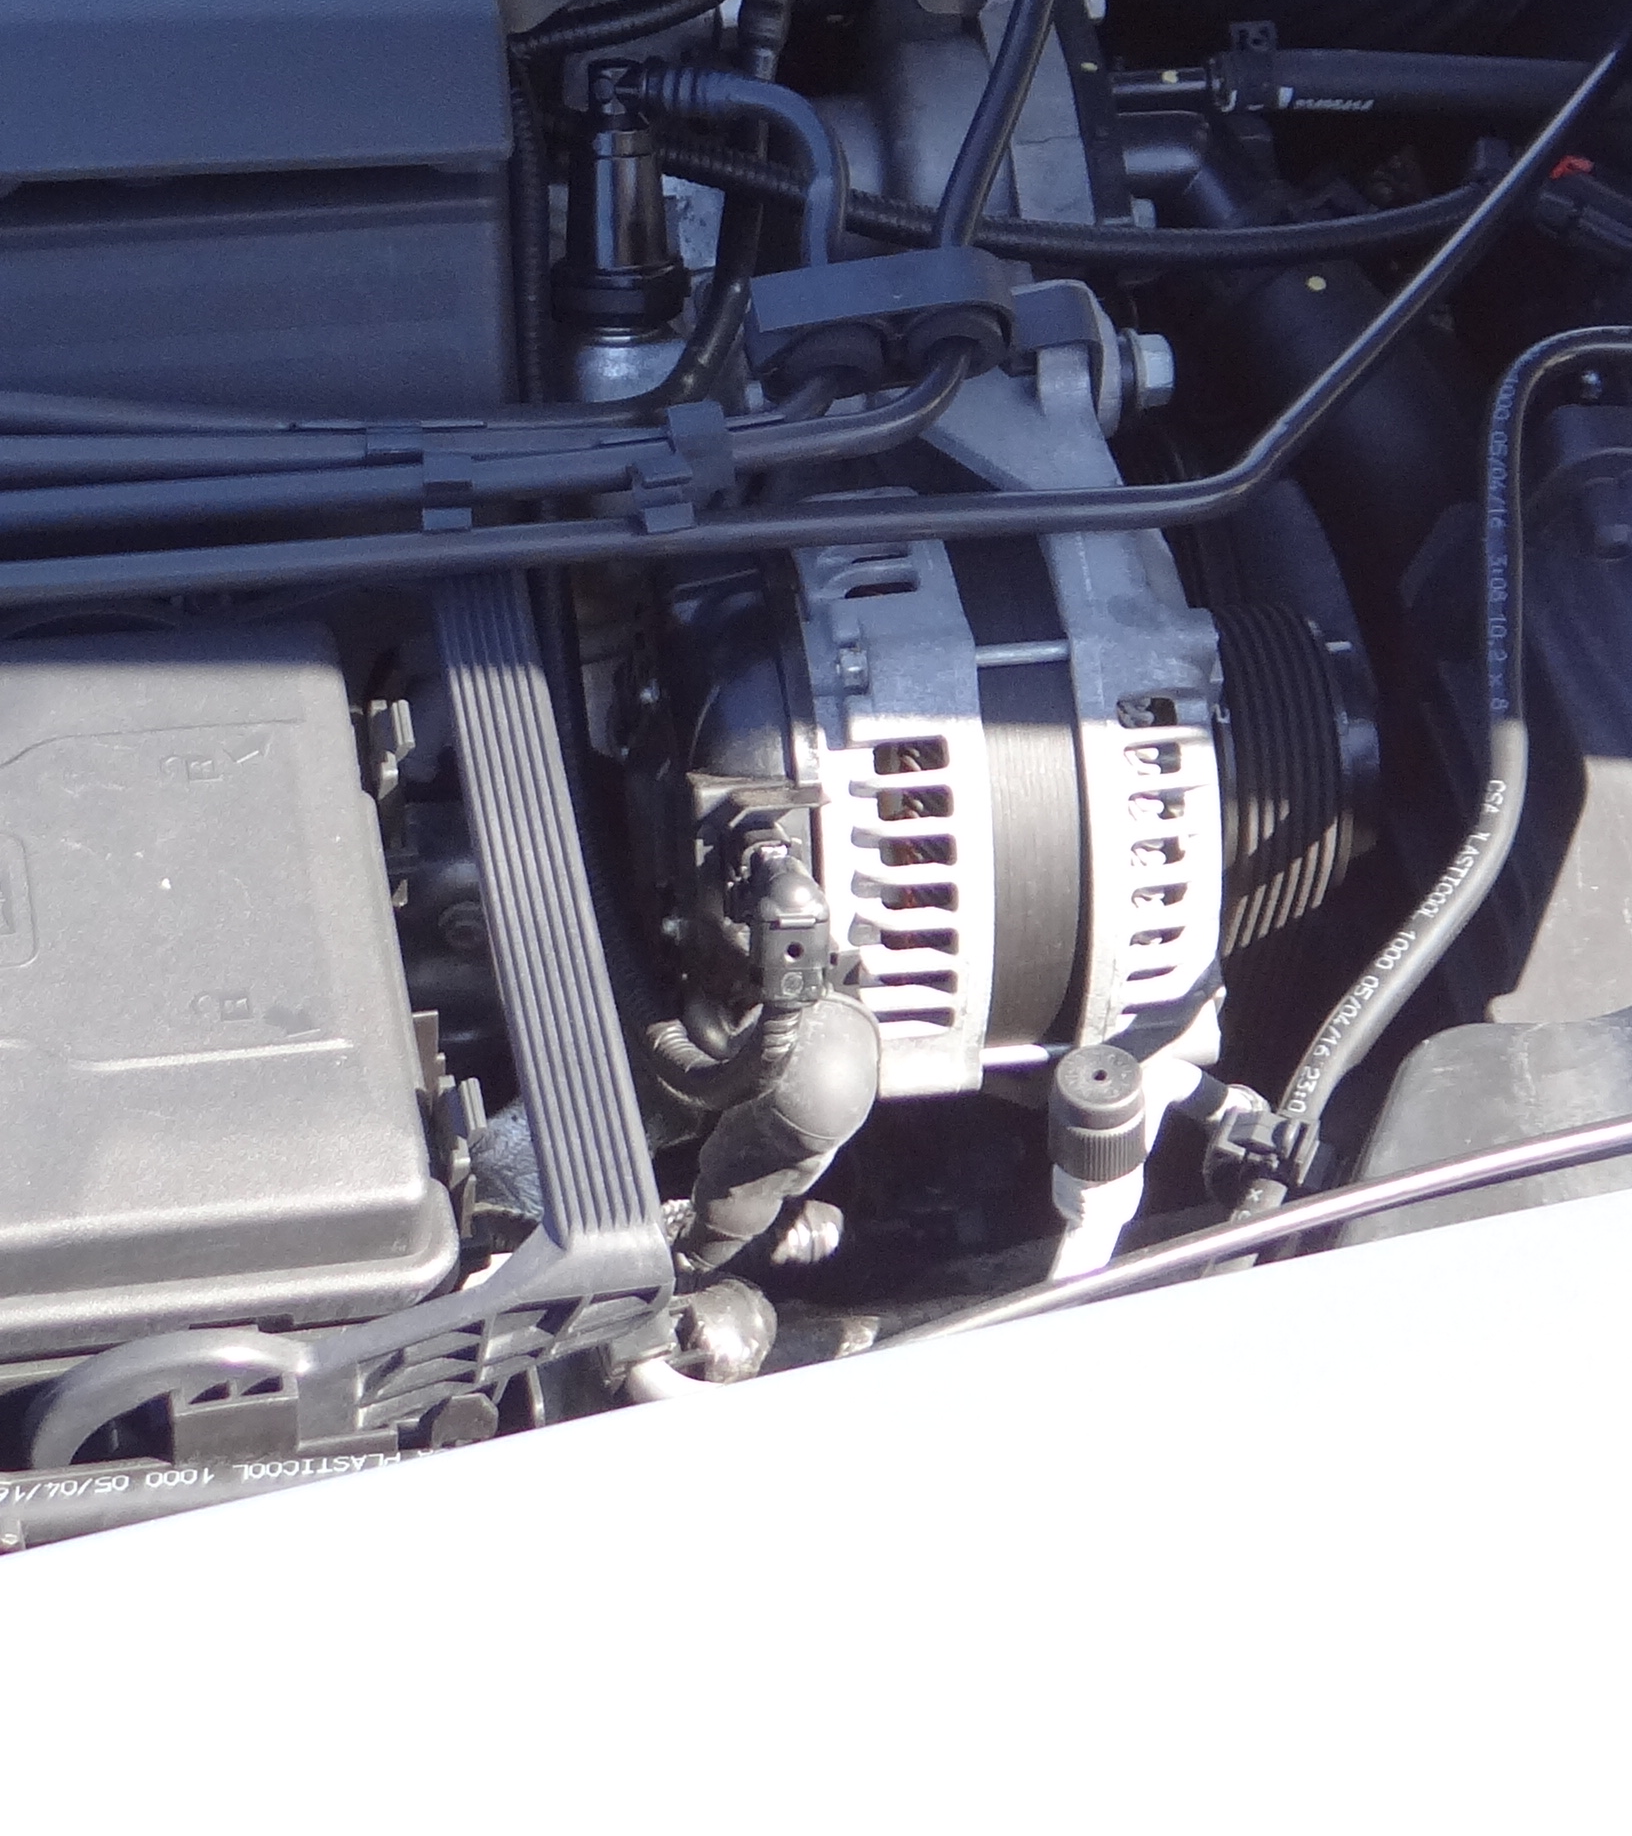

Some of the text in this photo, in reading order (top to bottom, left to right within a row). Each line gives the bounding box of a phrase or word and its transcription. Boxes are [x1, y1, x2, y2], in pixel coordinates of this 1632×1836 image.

[1483, 779, 1507, 814] CSA
[1375, 930, 1417, 971] 1000
[1313, 975, 1380, 1057] 05/04/16
[145, 1467, 215, 1487] 1000
